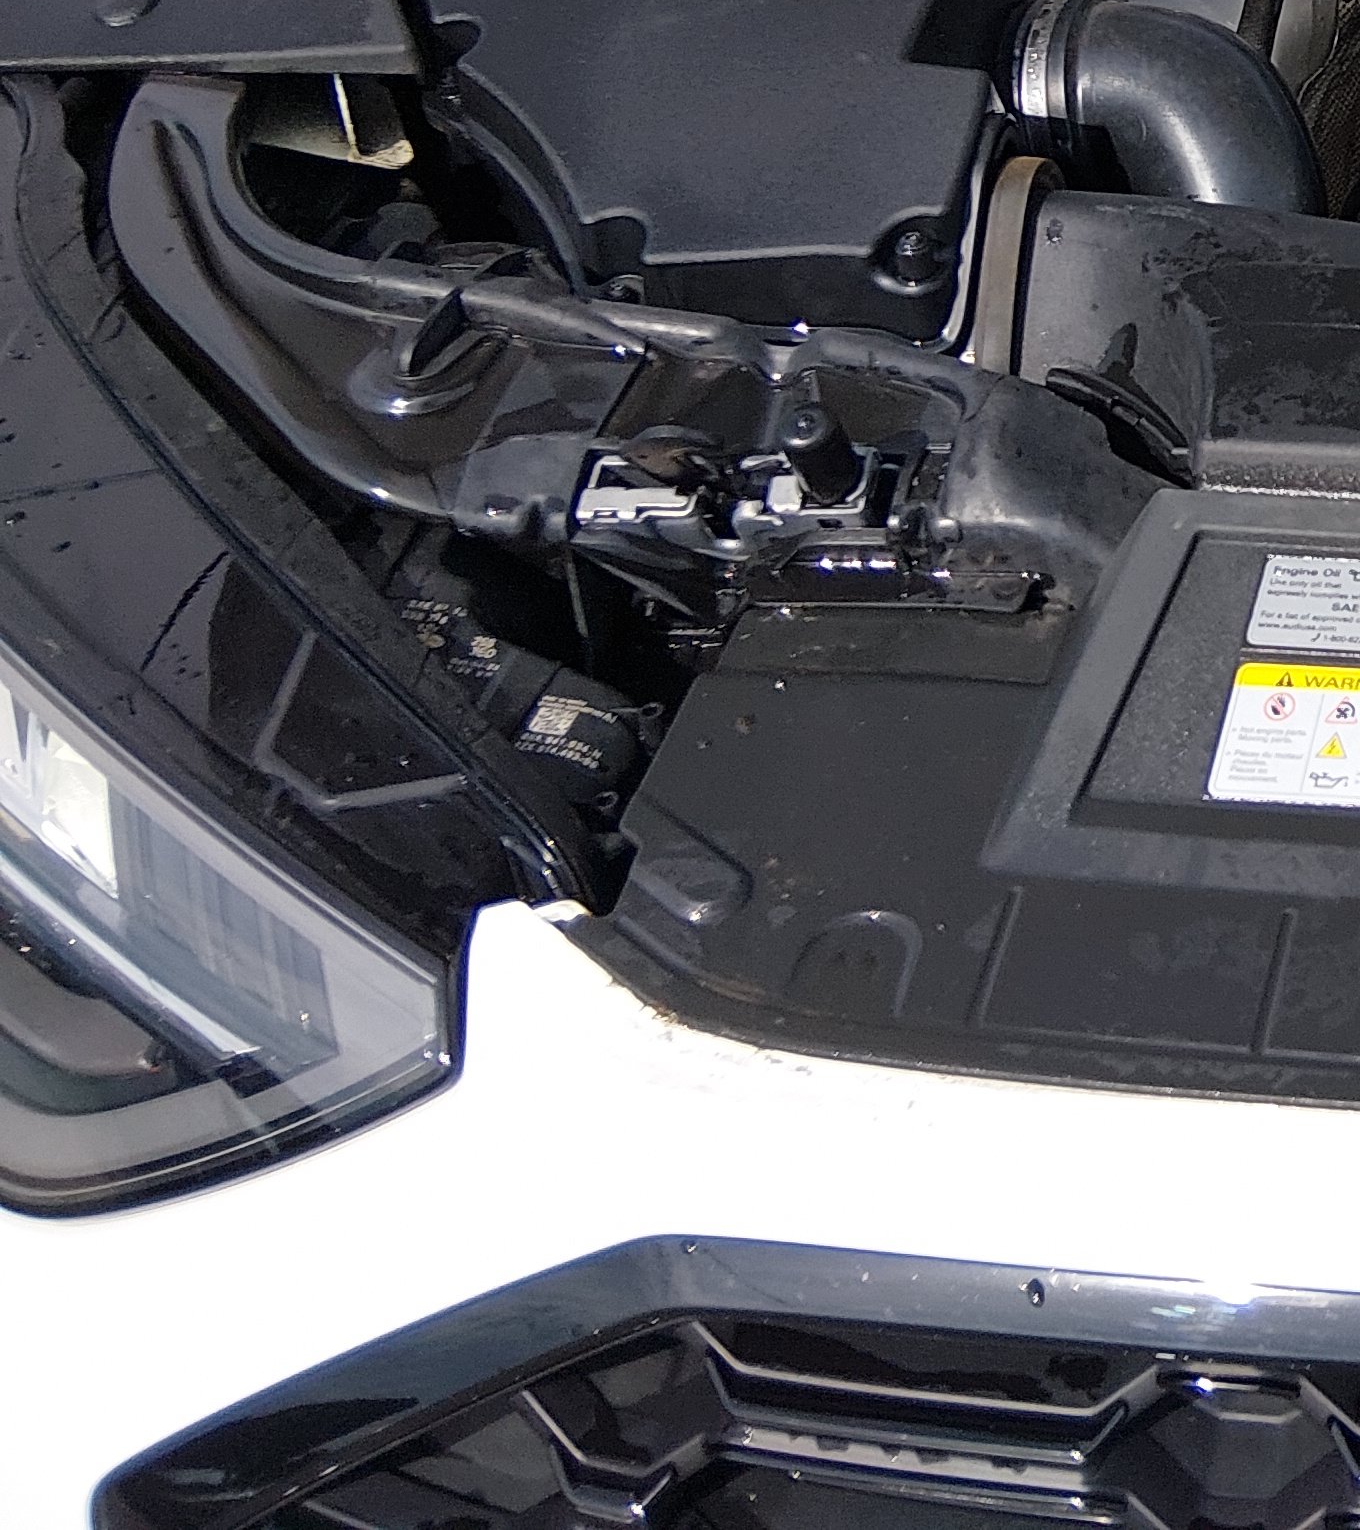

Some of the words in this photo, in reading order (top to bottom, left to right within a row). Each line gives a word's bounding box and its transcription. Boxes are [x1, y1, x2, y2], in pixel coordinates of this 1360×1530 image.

[1273, 565, 1319, 578] Engine
[1323, 567, 1341, 578] Oil
[1331, 602, 1360, 613] SAE
